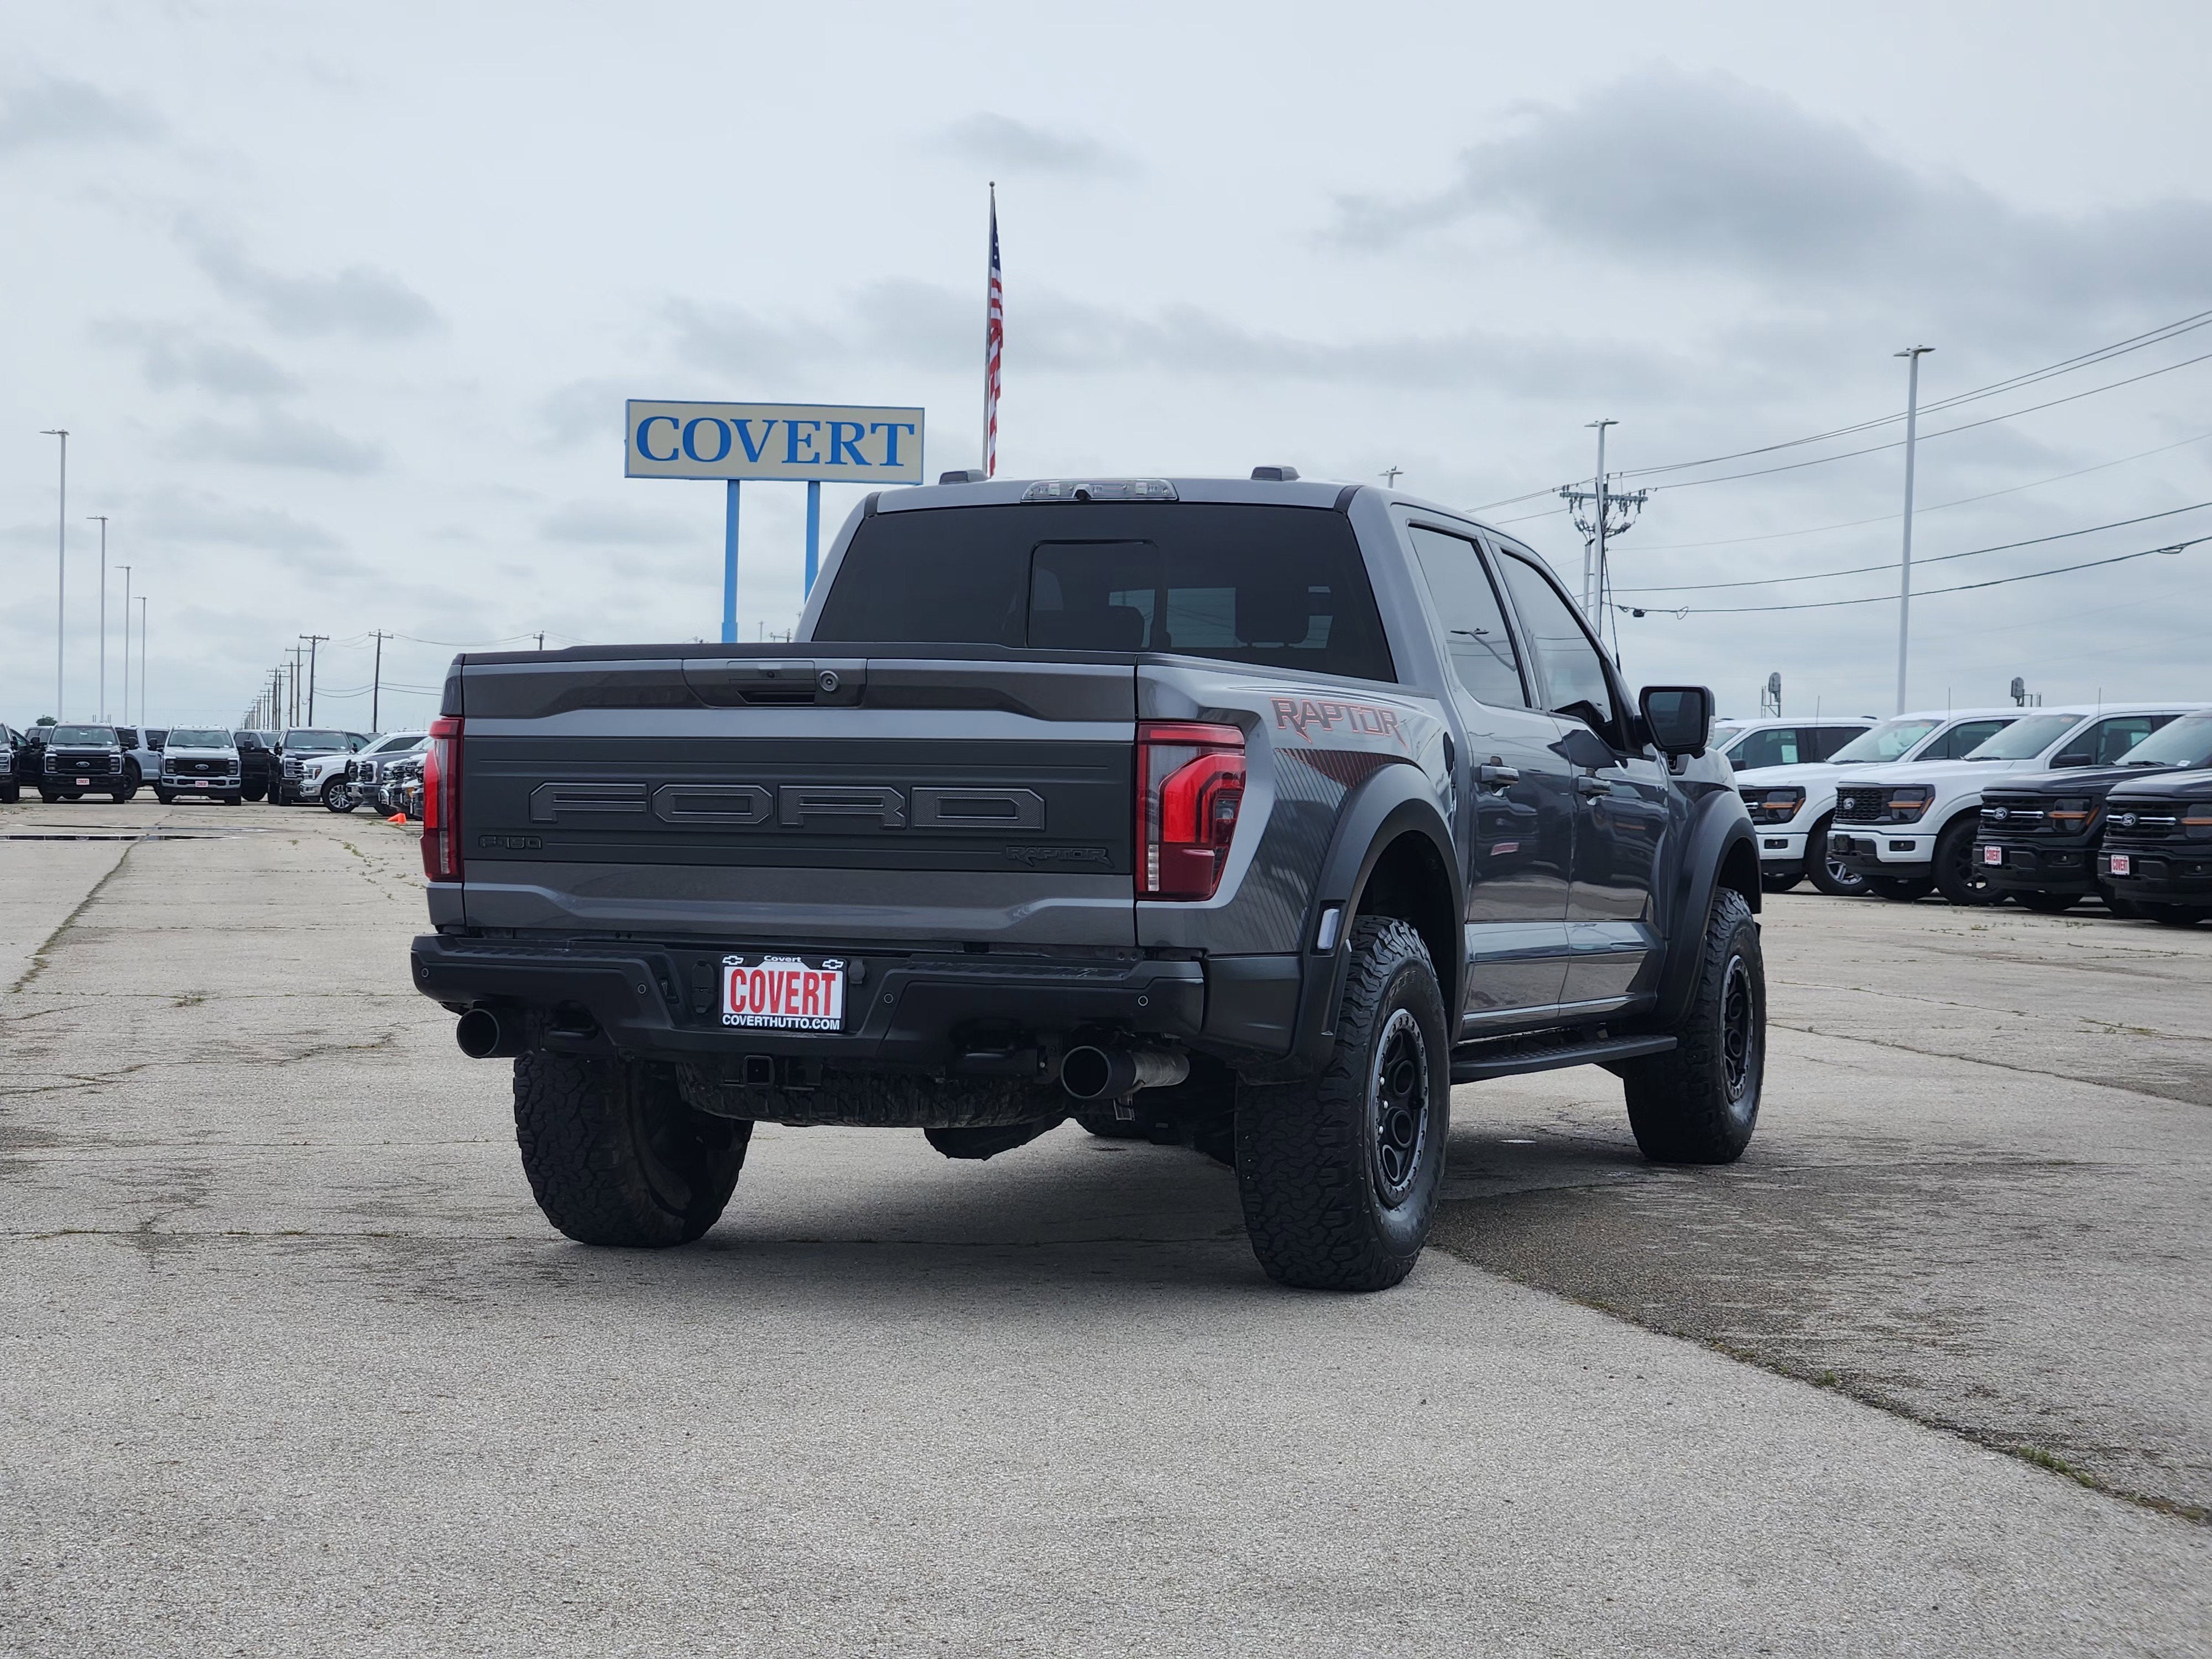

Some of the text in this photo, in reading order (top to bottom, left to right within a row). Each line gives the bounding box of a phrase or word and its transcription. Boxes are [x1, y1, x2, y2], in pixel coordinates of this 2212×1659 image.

[636, 416, 915, 466] COVERT
[1270, 697, 1407, 748] RAPTOR
[529, 781, 1046, 830] FORD
[1005, 846, 1114, 868] RAPTOR
[730, 968, 836, 1016] COVERT
[722, 1014, 841, 1030] COVERTHUTTO.COM
